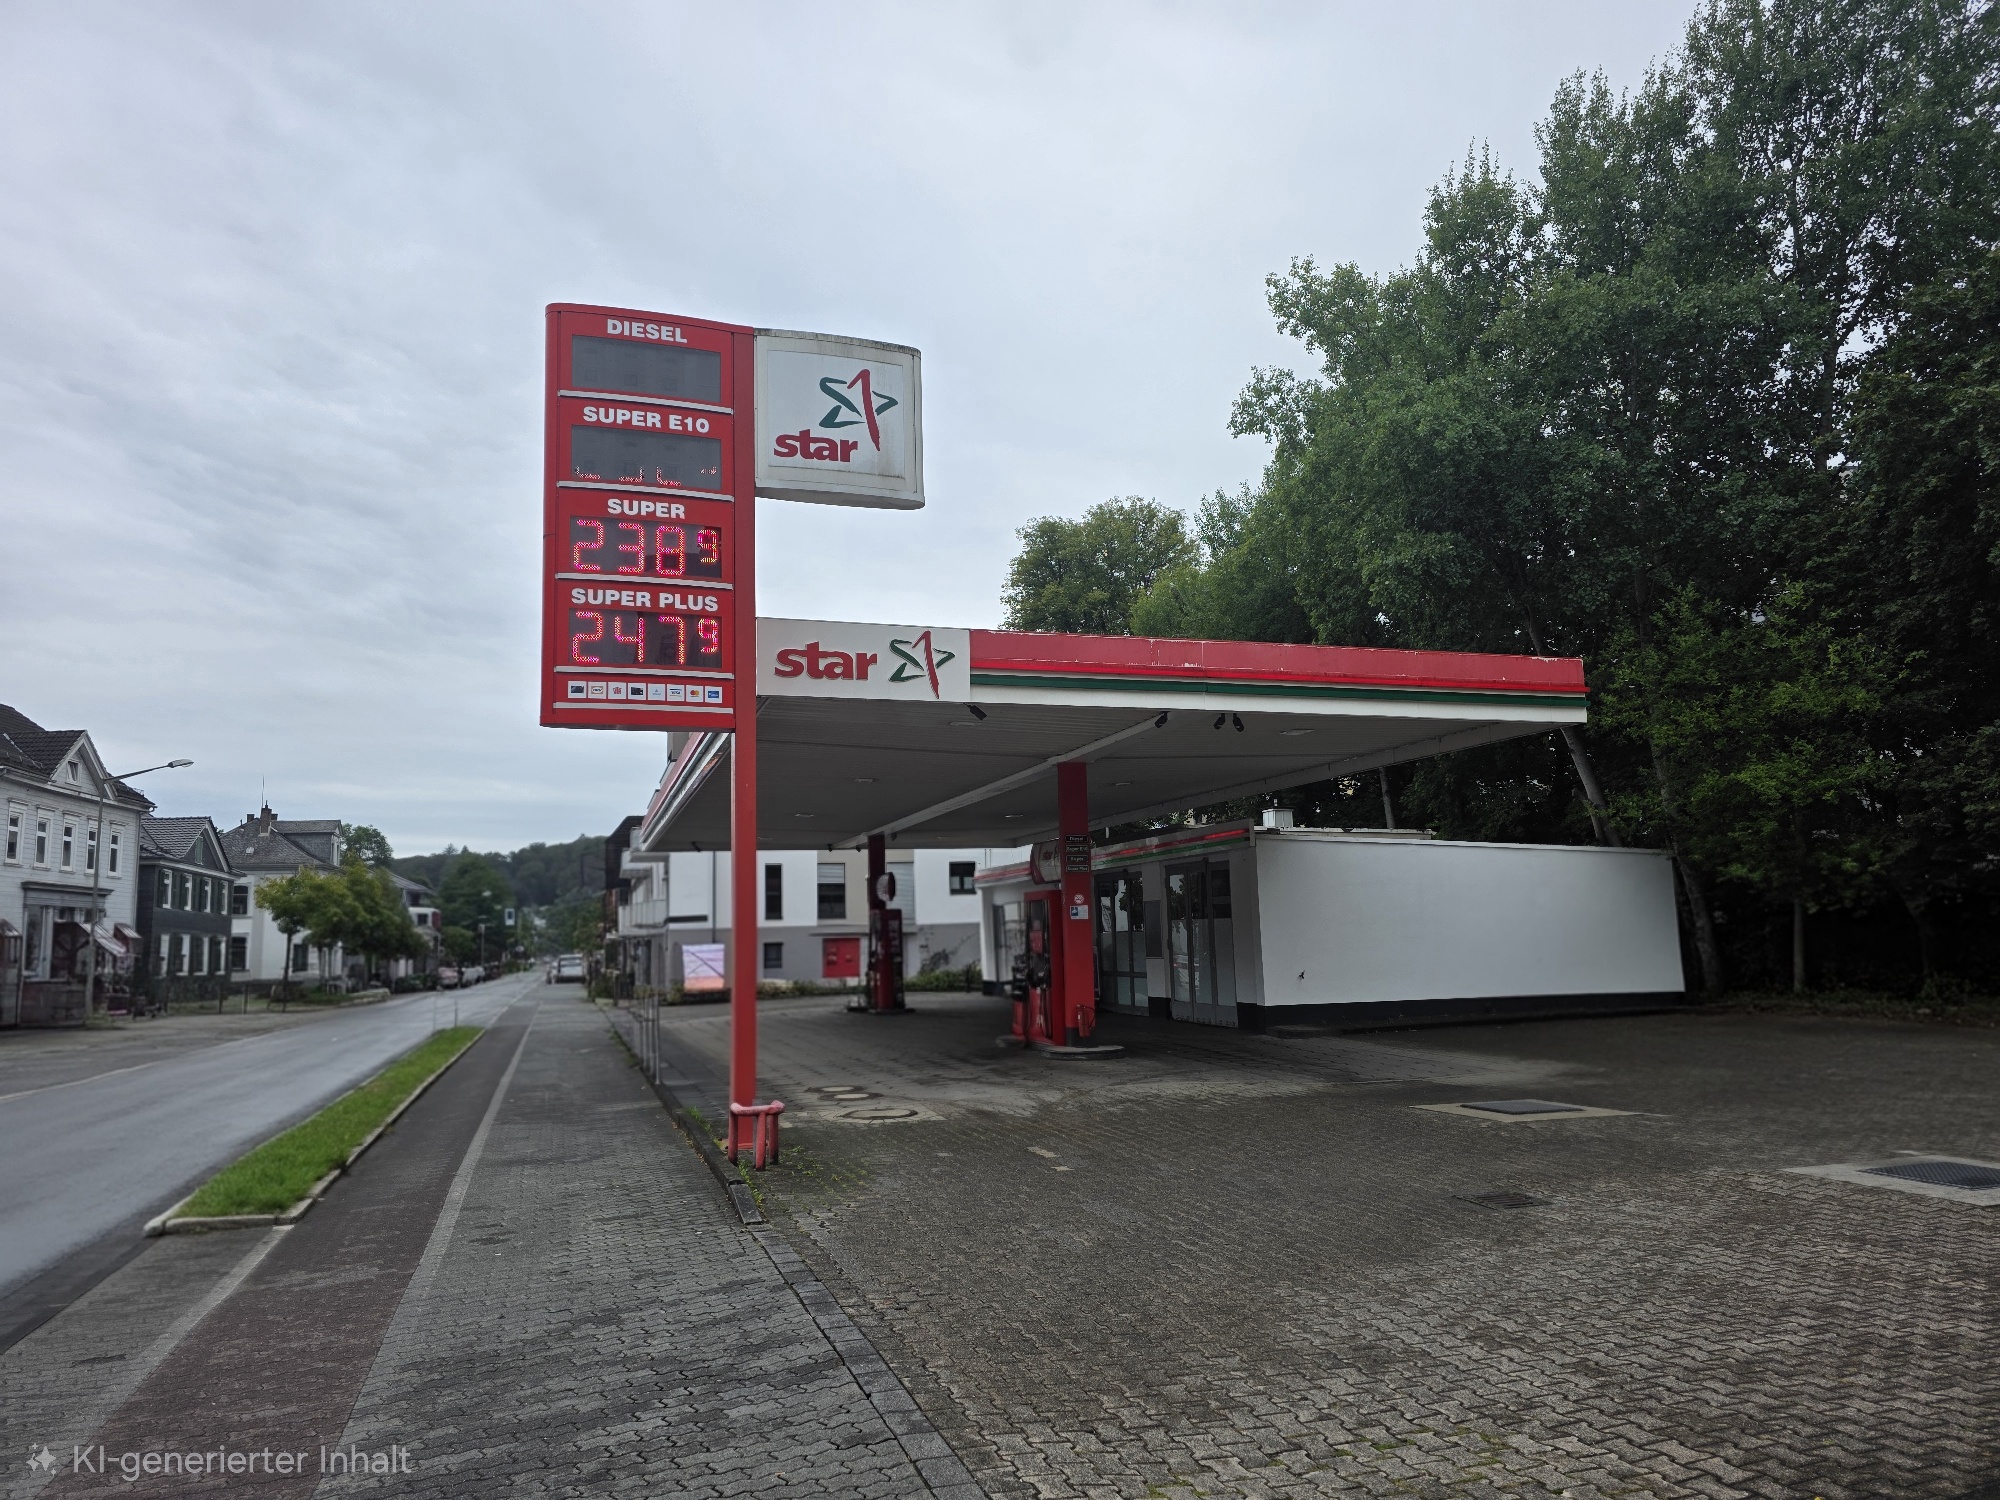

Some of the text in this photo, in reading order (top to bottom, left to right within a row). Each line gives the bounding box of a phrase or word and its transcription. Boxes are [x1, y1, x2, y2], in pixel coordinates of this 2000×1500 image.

[606, 318, 688, 344] DIESEL
[582, 406, 710, 434] SUPER E10
[773, 428, 859, 463] star
[606, 498, 686, 520] SUPER
[571, 587, 719, 612] SUPER PLUS
[774, 640, 878, 681] star
